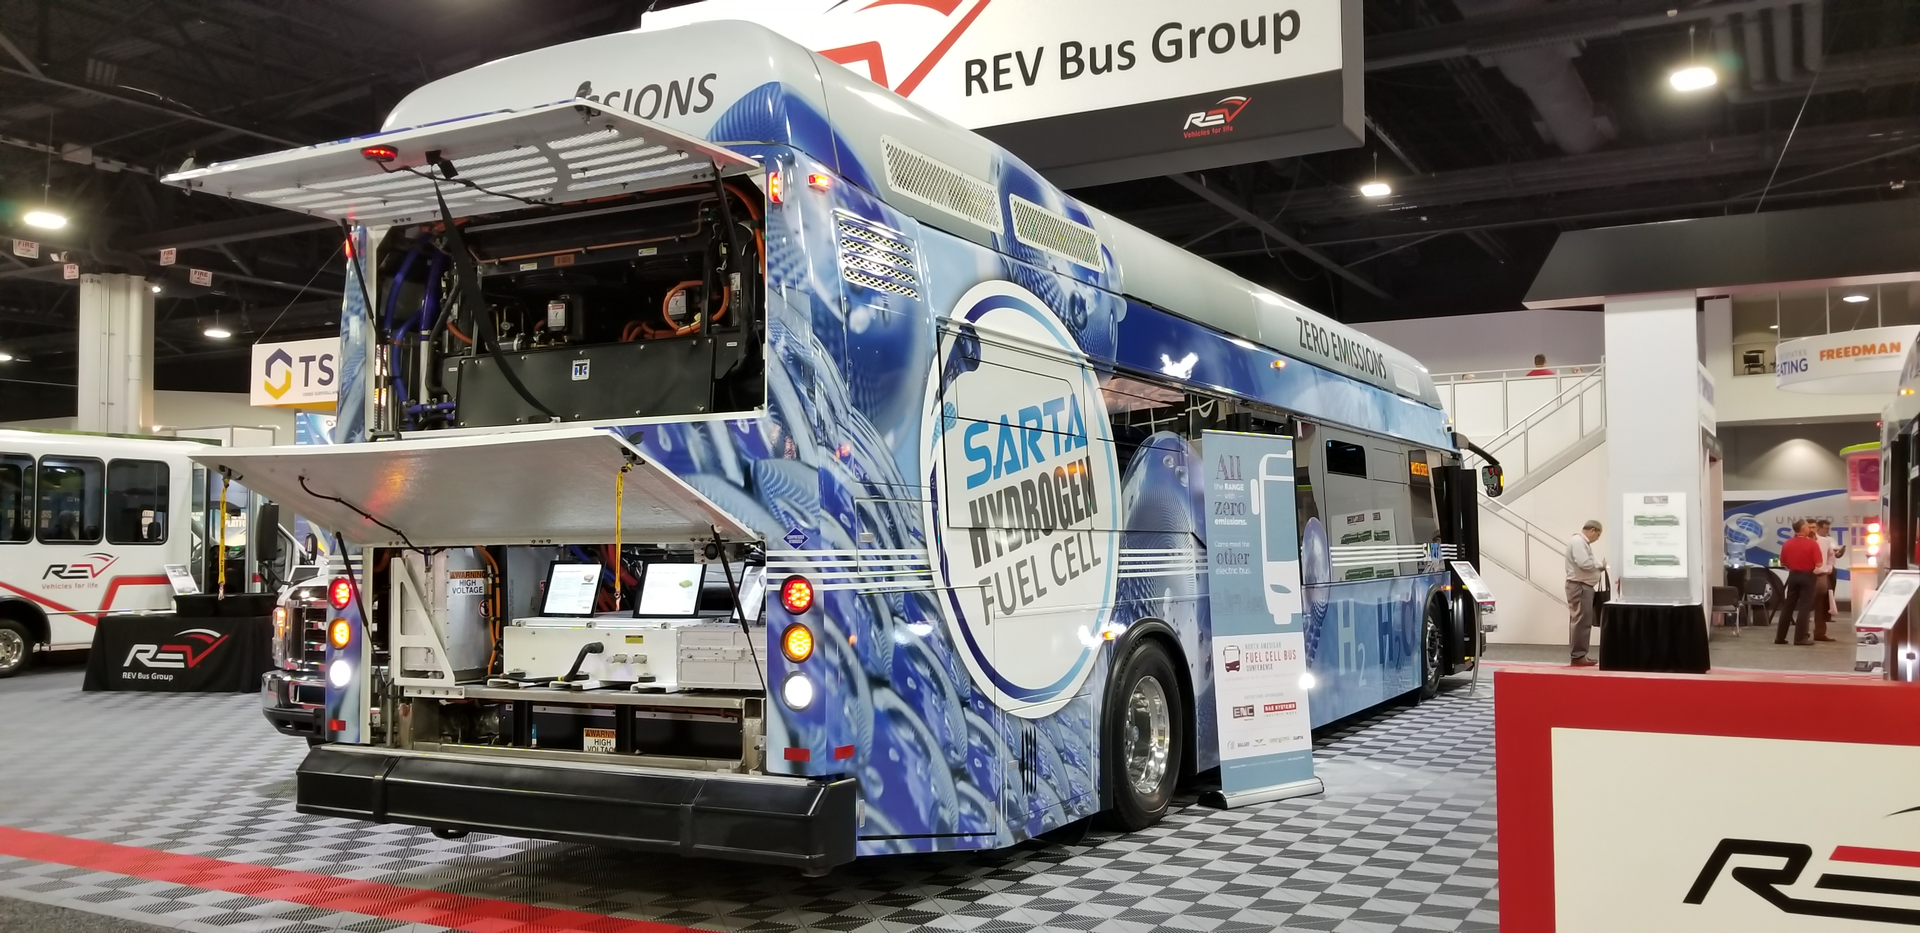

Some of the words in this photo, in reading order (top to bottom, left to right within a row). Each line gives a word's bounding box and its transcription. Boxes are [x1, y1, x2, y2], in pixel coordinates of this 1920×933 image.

[965, 46, 1044, 97] REV
[1060, 40, 1136, 80] Bus
[1152, 9, 1301, 63] Group
[1183, 97, 1252, 131] REV
[1183, 129, 1211, 139] Vehicles
[1212, 127, 1222, 135] for
[1223, 125, 1234, 133] life
[18, 241, 35, 249] FIRE
[194, 270, 208, 278] FIRE
[1296, 316, 1330, 358] ZERO
[1330, 331, 1387, 380] EMISSIONS
[1819, 341, 1901, 361] FREEDMAN
[299, 353, 334, 387] TS
[963, 393, 1088, 490] SARTA
[1216, 454, 1244, 481] All
[1214, 483, 1224, 491] the
[1224, 483, 1244, 491] RANGE
[968, 455, 1098, 569] HYDROGEN
[1214, 501, 1247, 515] zero
[1214, 517, 1248, 526] emissions.
[1216, 548, 1250, 566] other
[42, 556, 119, 579] REV
[1215, 567, 1239, 575] electric
[979, 555, 1047, 626] FUEL
[1050, 529, 1102, 586] CELL
[452, 586, 484, 594] VOLTAGE
[123, 634, 229, 669] REV
[1246, 652, 1263, 663] FUEL
[1265, 650, 1282, 662] CELL
[1284, 649, 1297, 660] BUS
[122, 672, 137, 680] REV
[138, 672, 150, 680] Bus
[151, 672, 173, 682] Group
[1234, 706, 1254, 717] ENC
[1683, 837, 1920, 926] RE
